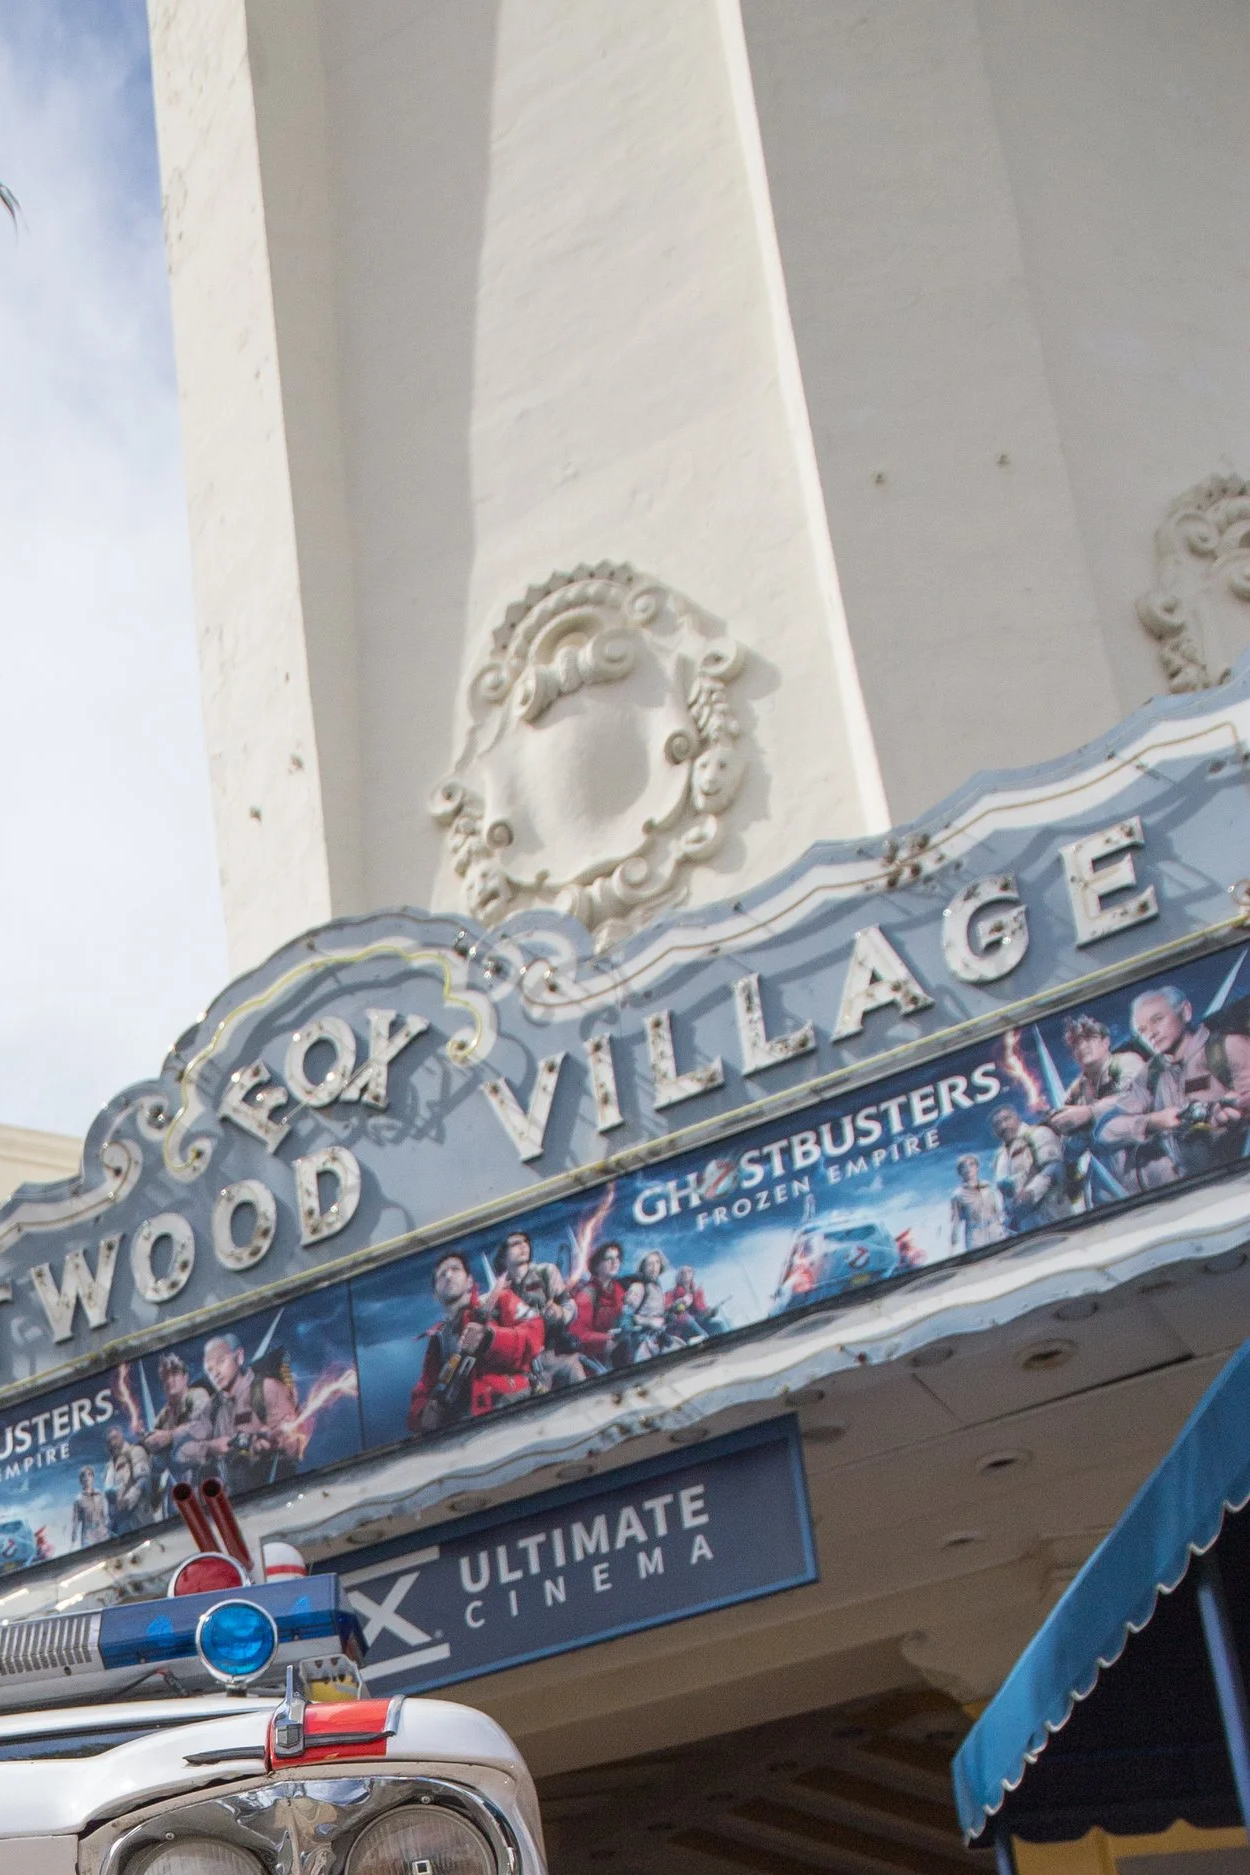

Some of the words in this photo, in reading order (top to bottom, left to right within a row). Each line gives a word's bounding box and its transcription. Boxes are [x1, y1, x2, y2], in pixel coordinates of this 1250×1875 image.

[479, 815, 1160, 1163] VILLAGE
[217, 1007, 431, 1155] FOX
[696, 1176, 811, 1231] FROZEN
[827, 1128, 941, 1186] EMPIRE
[458, 1483, 710, 1594] ULTIMATE
[464, 1537, 714, 1629] CINEMA
